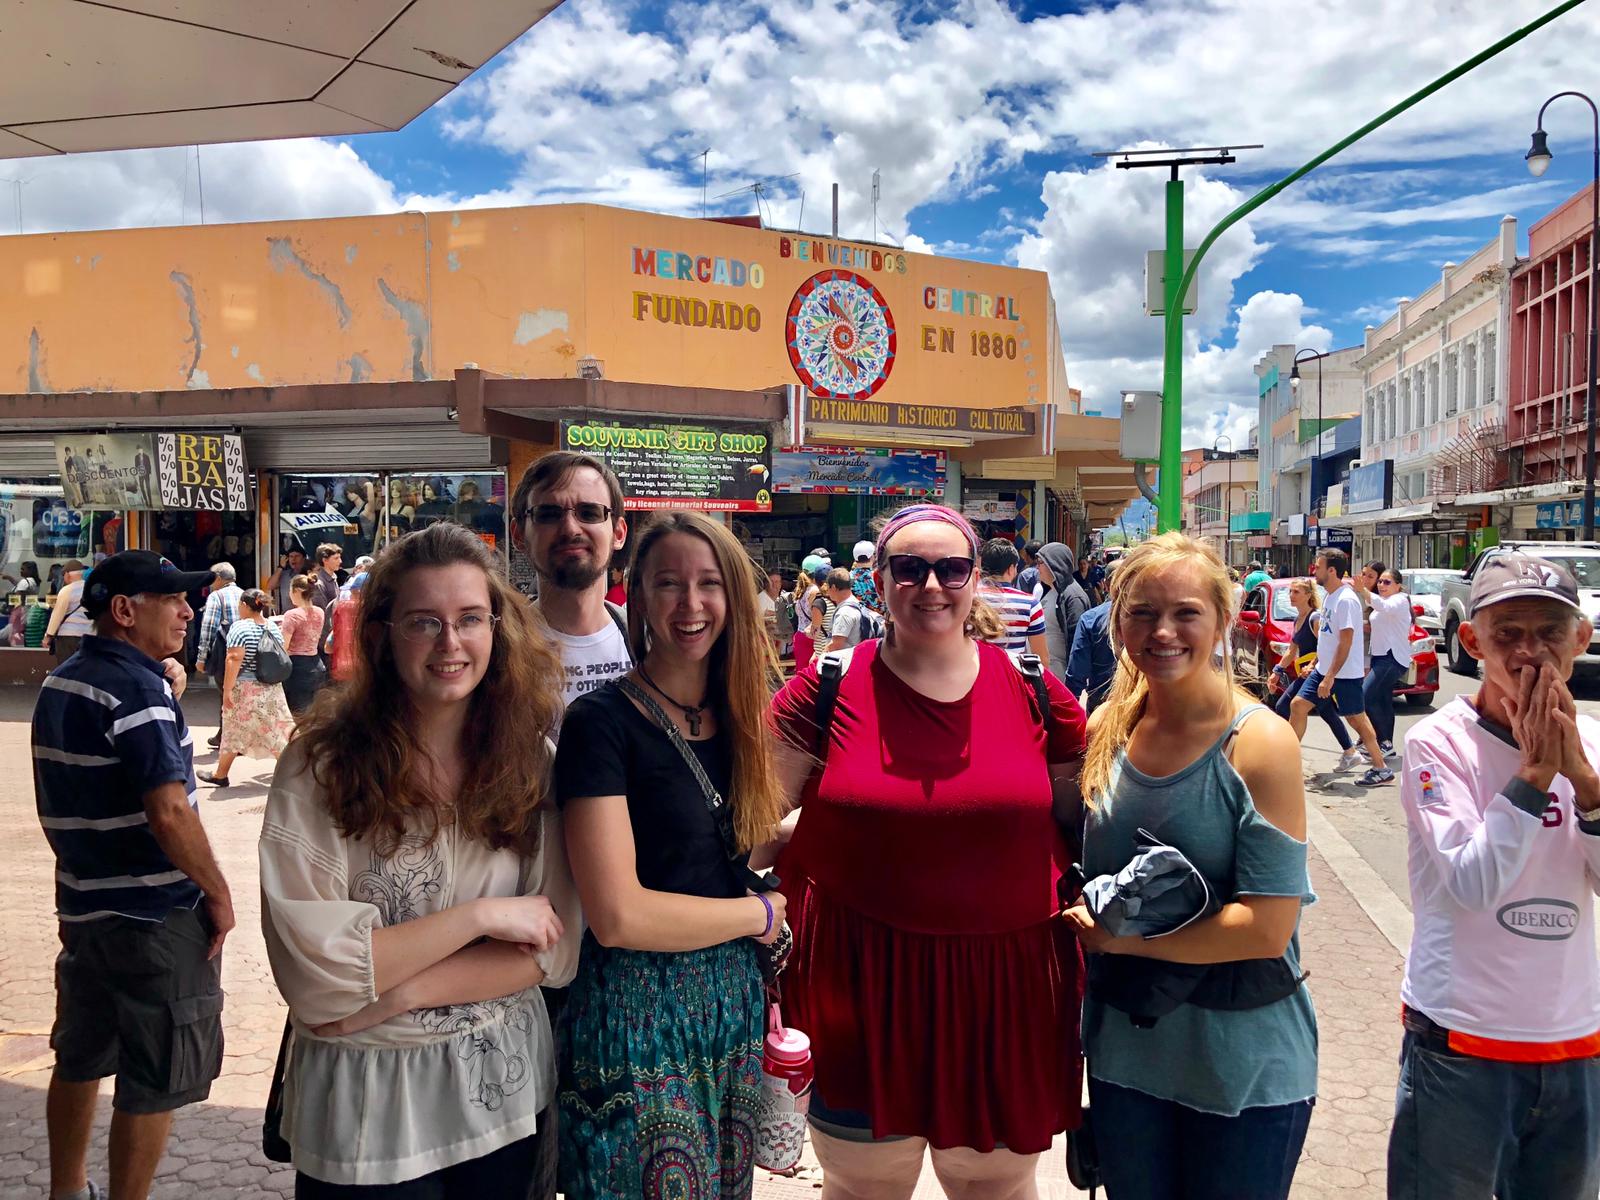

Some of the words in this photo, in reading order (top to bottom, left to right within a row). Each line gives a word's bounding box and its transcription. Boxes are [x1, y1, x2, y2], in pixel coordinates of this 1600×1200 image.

[632, 247, 765, 289] MERCADO
[780, 237, 907, 274] BIENVENIDOS
[632, 291, 761, 332] FUNDADO
[923, 286, 1020, 321] CENTRAL
[921, 324, 955, 354] EN
[970, 330, 1017, 360] 1880
[811, 399, 889, 425] PATRIMONIO
[970, 410, 1026, 432] CULTURAL
[177, 434, 223, 463] RE
[568, 425, 670, 449] SOUVENIR
[675, 431, 717, 452] GIFT
[720, 433, 767, 454] SHOP
[67, 465, 146, 483] DESCUENTOS
[178, 459, 226, 488] BA
[817, 455, 871, 467] Bienvenidos
[807, 470, 845, 481] Mercado
[847, 471, 880, 483] Central
[180, 486, 225, 512] JAS
[638, 500, 670, 509] licensed
[671, 501, 702, 509] Imperial
[704, 501, 739, 509] Souvenirs
[586, 660, 632, 676] PEOPLE
